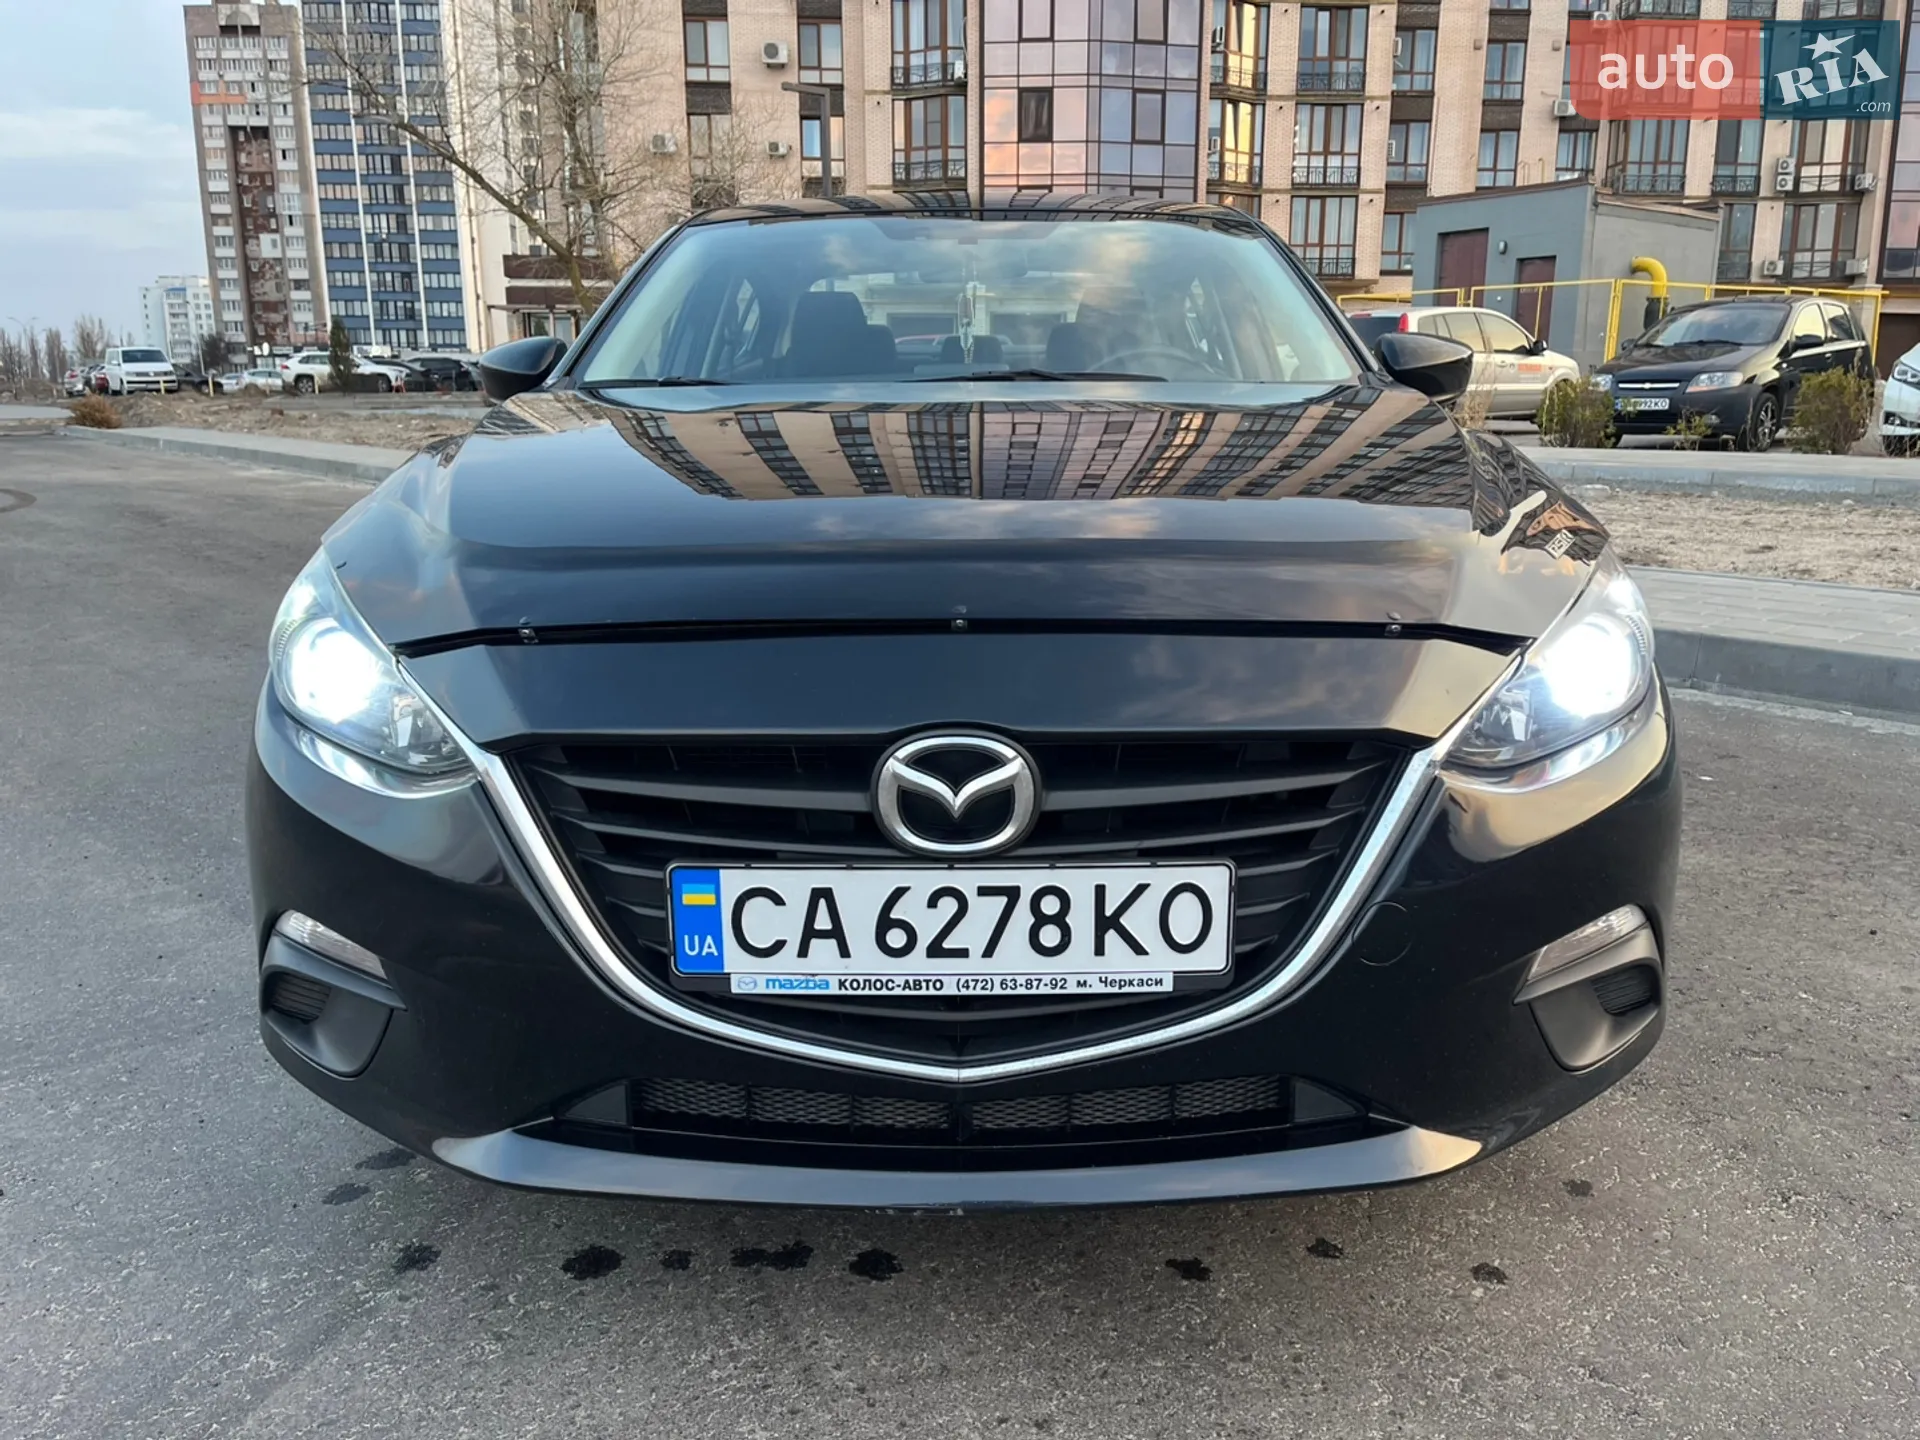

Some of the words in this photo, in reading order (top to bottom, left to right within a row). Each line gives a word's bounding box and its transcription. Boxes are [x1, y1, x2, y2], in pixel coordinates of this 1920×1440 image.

[730, 886, 852, 960] CA
[874, 885, 1072, 959] 6278
[1093, 881, 1213, 957] KO
[683, 934, 719, 957] UA
[765, 976, 830, 991] mazda
[837, 978, 945, 992] КОЛОС-АВТО
[955, 977, 995, 993] (472)
[999, 977, 1068, 991] 63-87-92
[1076, 979, 1093, 989] м.
[1098, 975, 1164, 990] Черкаси
